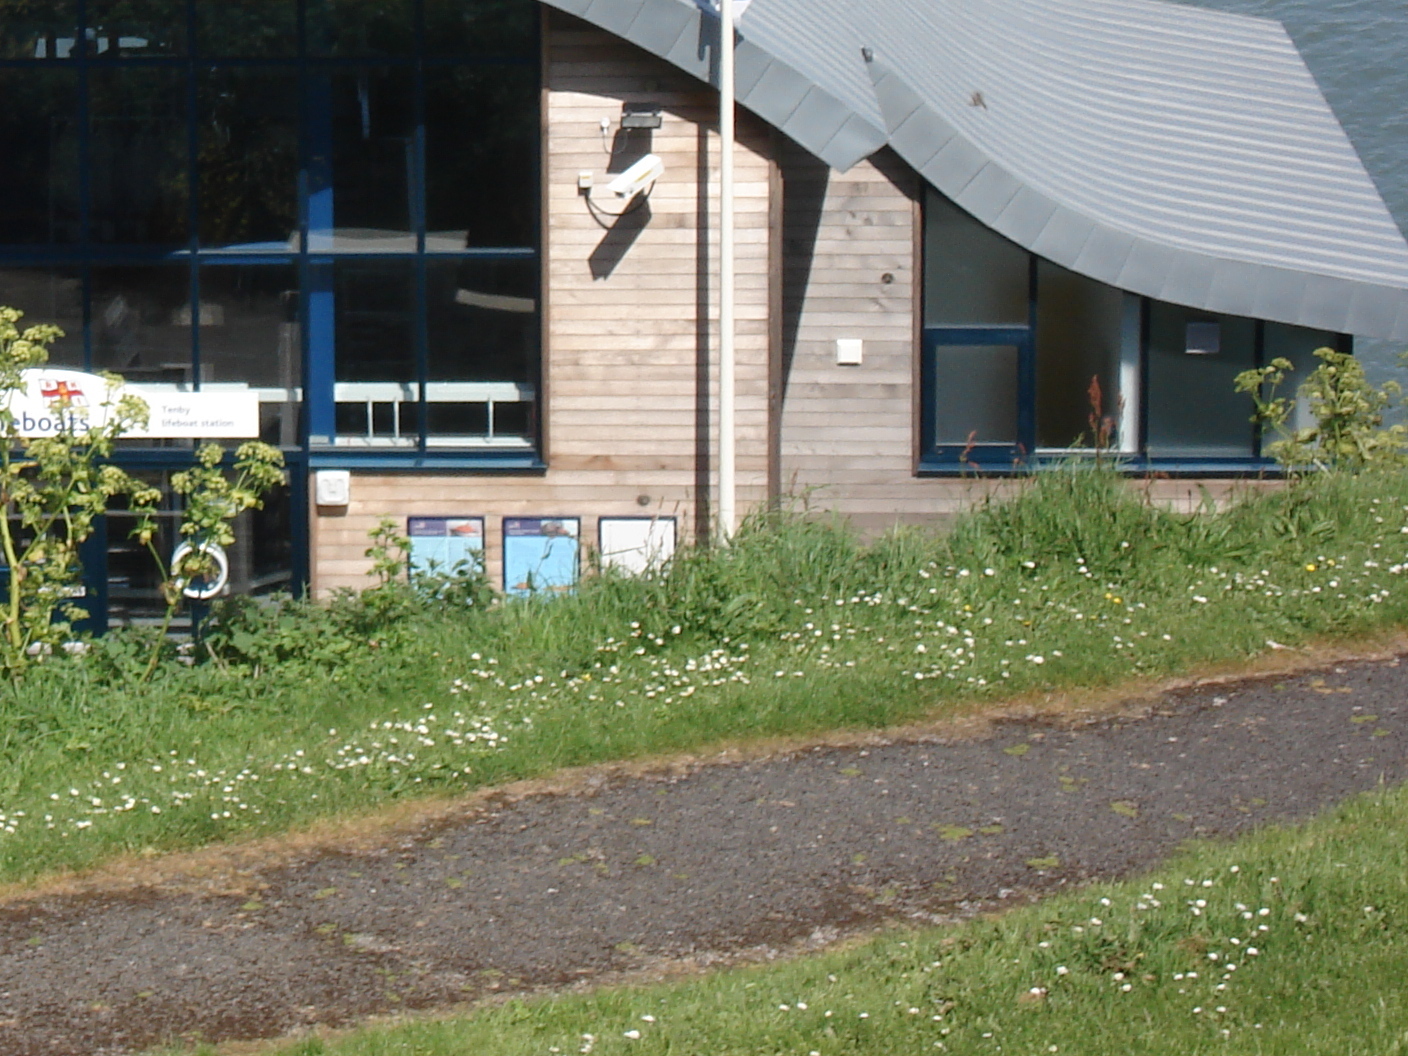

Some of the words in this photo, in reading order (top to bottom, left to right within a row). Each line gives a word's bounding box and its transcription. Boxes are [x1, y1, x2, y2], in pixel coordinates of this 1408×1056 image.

[161, 405, 191, 416] Tenby
[161, 418, 198, 428] lifeboat
[200, 418, 235, 428] station
